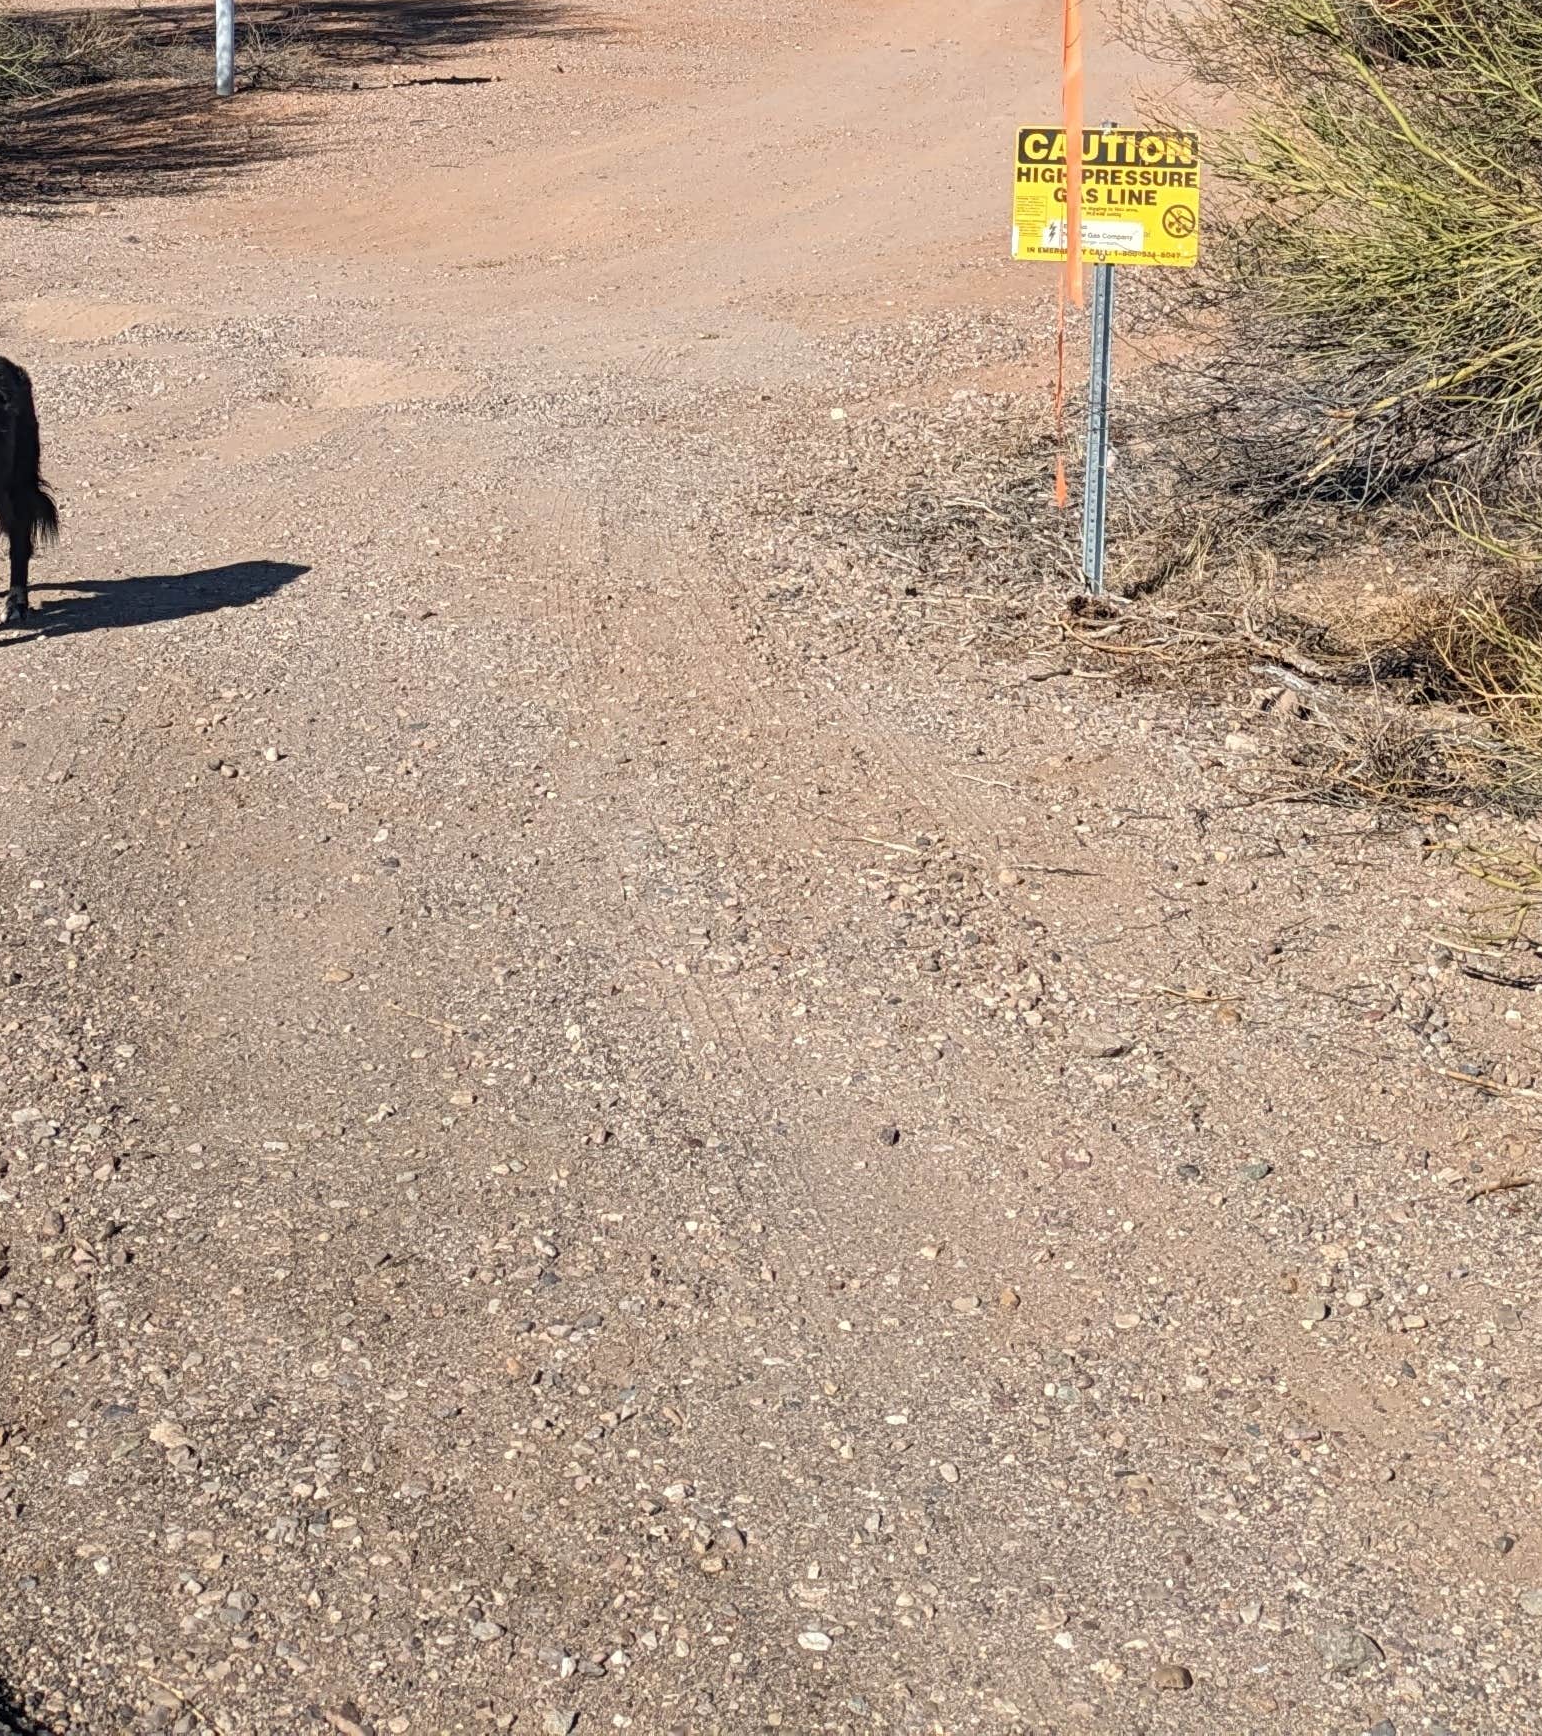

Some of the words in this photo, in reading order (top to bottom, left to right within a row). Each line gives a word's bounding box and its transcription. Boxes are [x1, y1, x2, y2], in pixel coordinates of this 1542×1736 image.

[1024, 133, 1193, 164] CAUTION
[1081, 169, 1198, 188] PRESSURE
[1054, 188, 1098, 204] GS
[1106, 189, 1158, 206] LINE
[1102, 233, 1133, 241] Company
